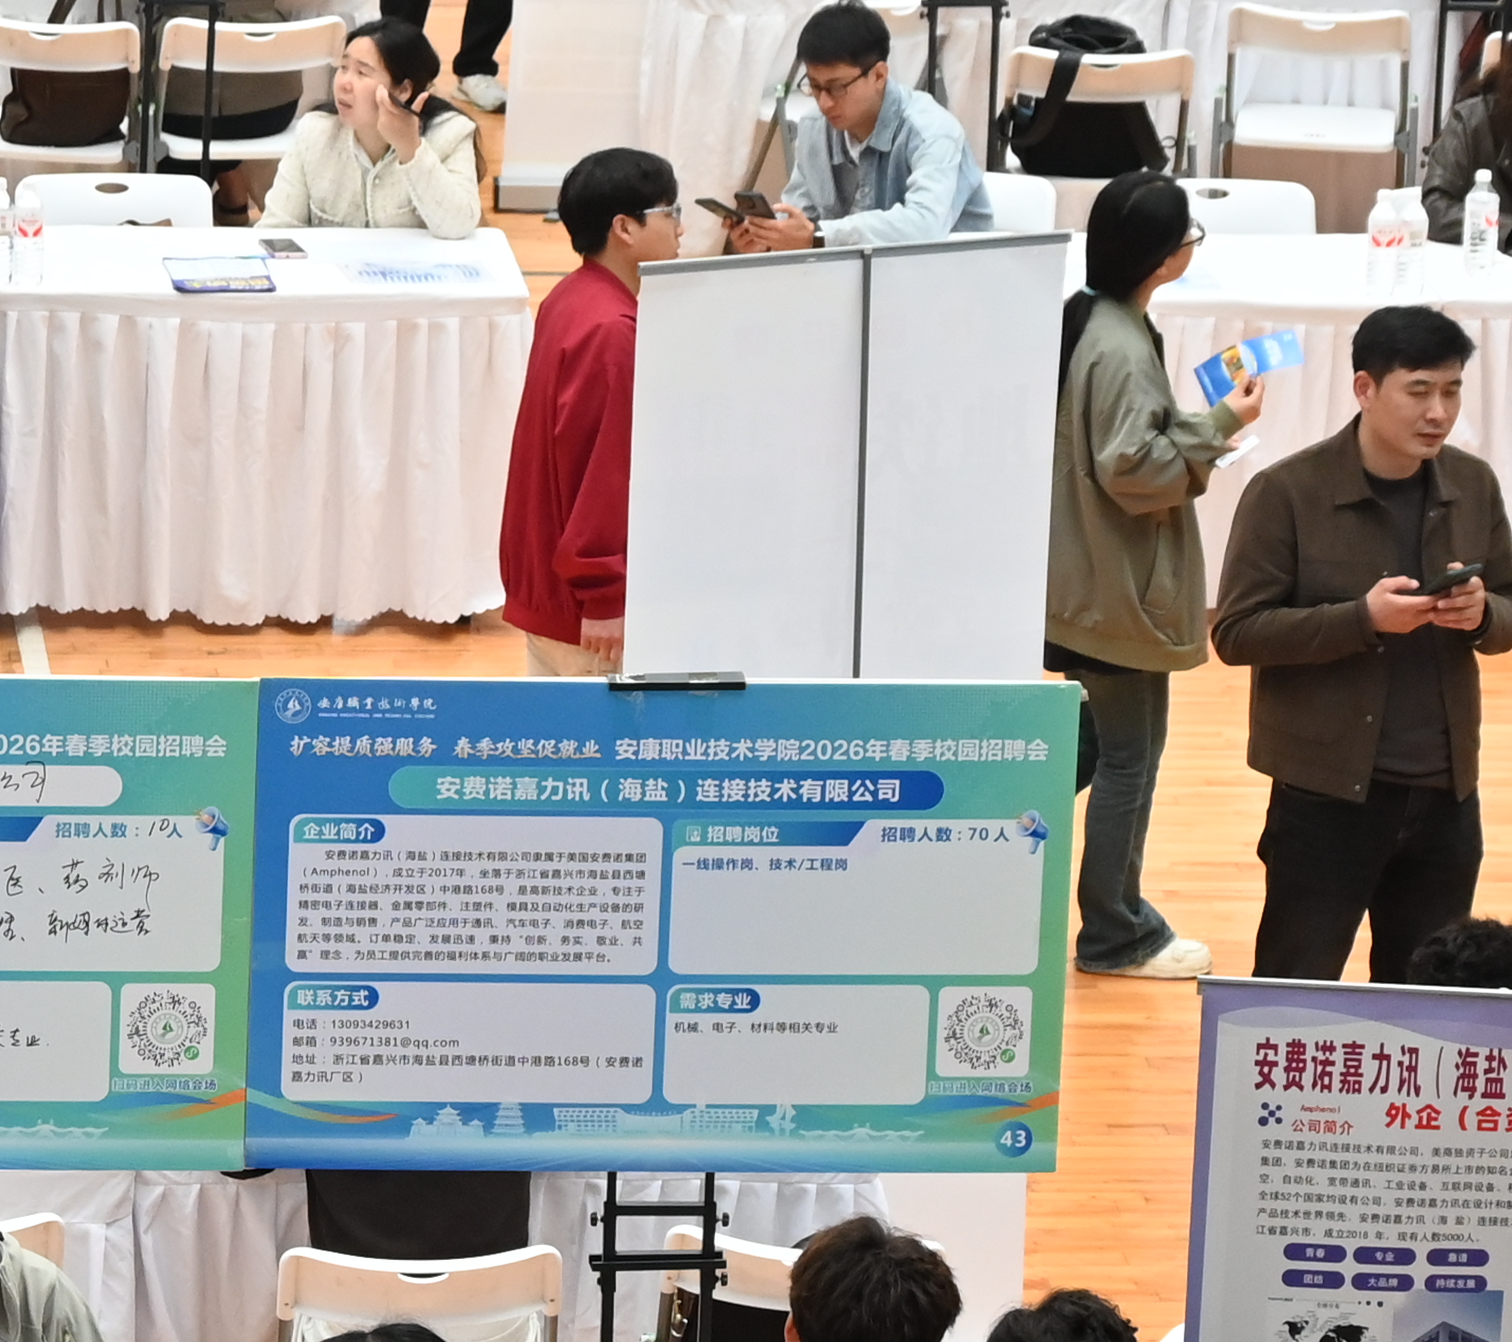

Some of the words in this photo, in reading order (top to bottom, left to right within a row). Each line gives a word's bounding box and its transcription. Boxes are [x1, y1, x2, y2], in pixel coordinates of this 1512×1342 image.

[289, 736, 438, 760] 扩容提质强服务
[614, 738, 1049, 764] 安康职业技术学院2026年春季校园招聘会
[435, 775, 902, 807] 安费诺嘉力讯（海盐）连接技术有限公司
[301, 822, 376, 842] 企业简介
[705, 824, 780, 845] 招聘岗位
[681, 857, 849, 874] 一线操作岗、技术/工程岗
[296, 987, 370, 1008] 联系方式
[678, 990, 753, 1012] 需求专业
[673, 1020, 840, 1036] 机械、电子、材料等相关专业
[1291, 1118, 1355, 1135] 公司简介
[999, 1130, 1028, 1149] 43
[1373, 1249, 1396, 1263] 专业
[1367, 1275, 1399, 1288] 大品牌
